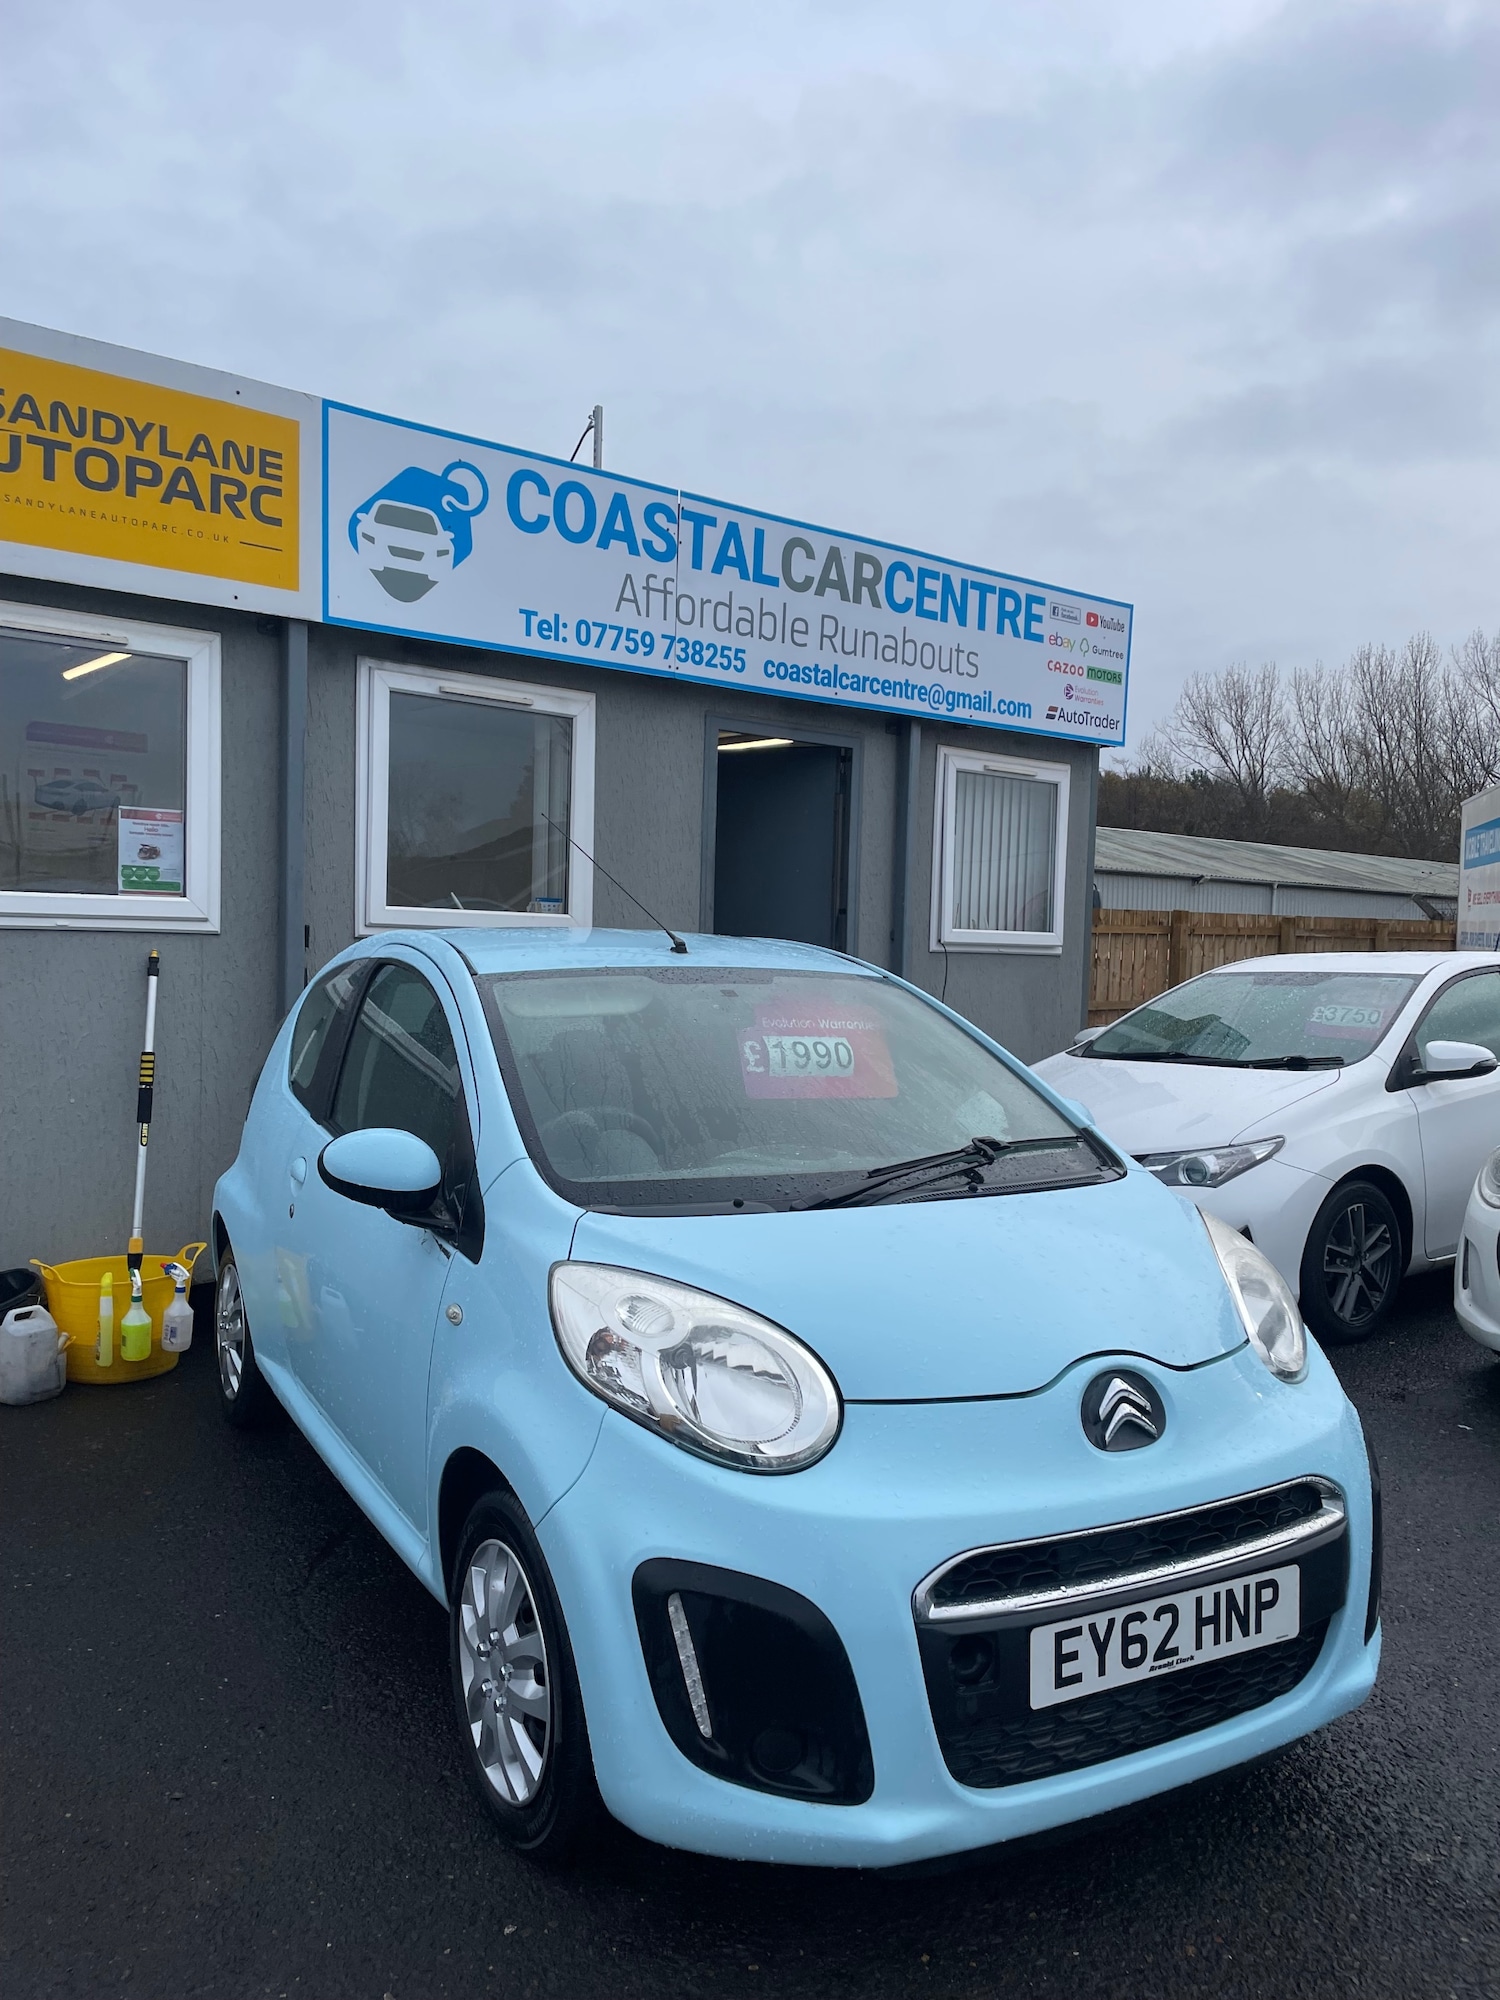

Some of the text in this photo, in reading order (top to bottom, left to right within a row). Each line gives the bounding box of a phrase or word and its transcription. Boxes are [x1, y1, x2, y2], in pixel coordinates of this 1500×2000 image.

[0, 387, 283, 483] ANDYLANE
[4, 493, 230, 544] SANDYLANEAUTOPARC.CO.UK
[615, 572, 980, 680] Affordable Runabouts
[1100, 614, 1125, 633] YouTube
[518, 608, 746, 674] Tel: 07759 738255
[1048, 631, 1076, 653] ebay
[1092, 645, 1125, 660] Gumtree
[763, 658, 1033, 720] coastalcarcentre@gmail.com
[1074, 685, 1099, 696] Evolution
[1074, 694, 1104, 706] Warranties
[1057, 706, 1121, 731] AutoTrader
[762, 1016, 878, 1031] Evolution Warrantie
[1310, 1006, 1382, 1025] £3750
[1054, 1577, 1279, 1690] EY62 HNP
[1148, 1654, 1196, 1673] Arnold Clark
